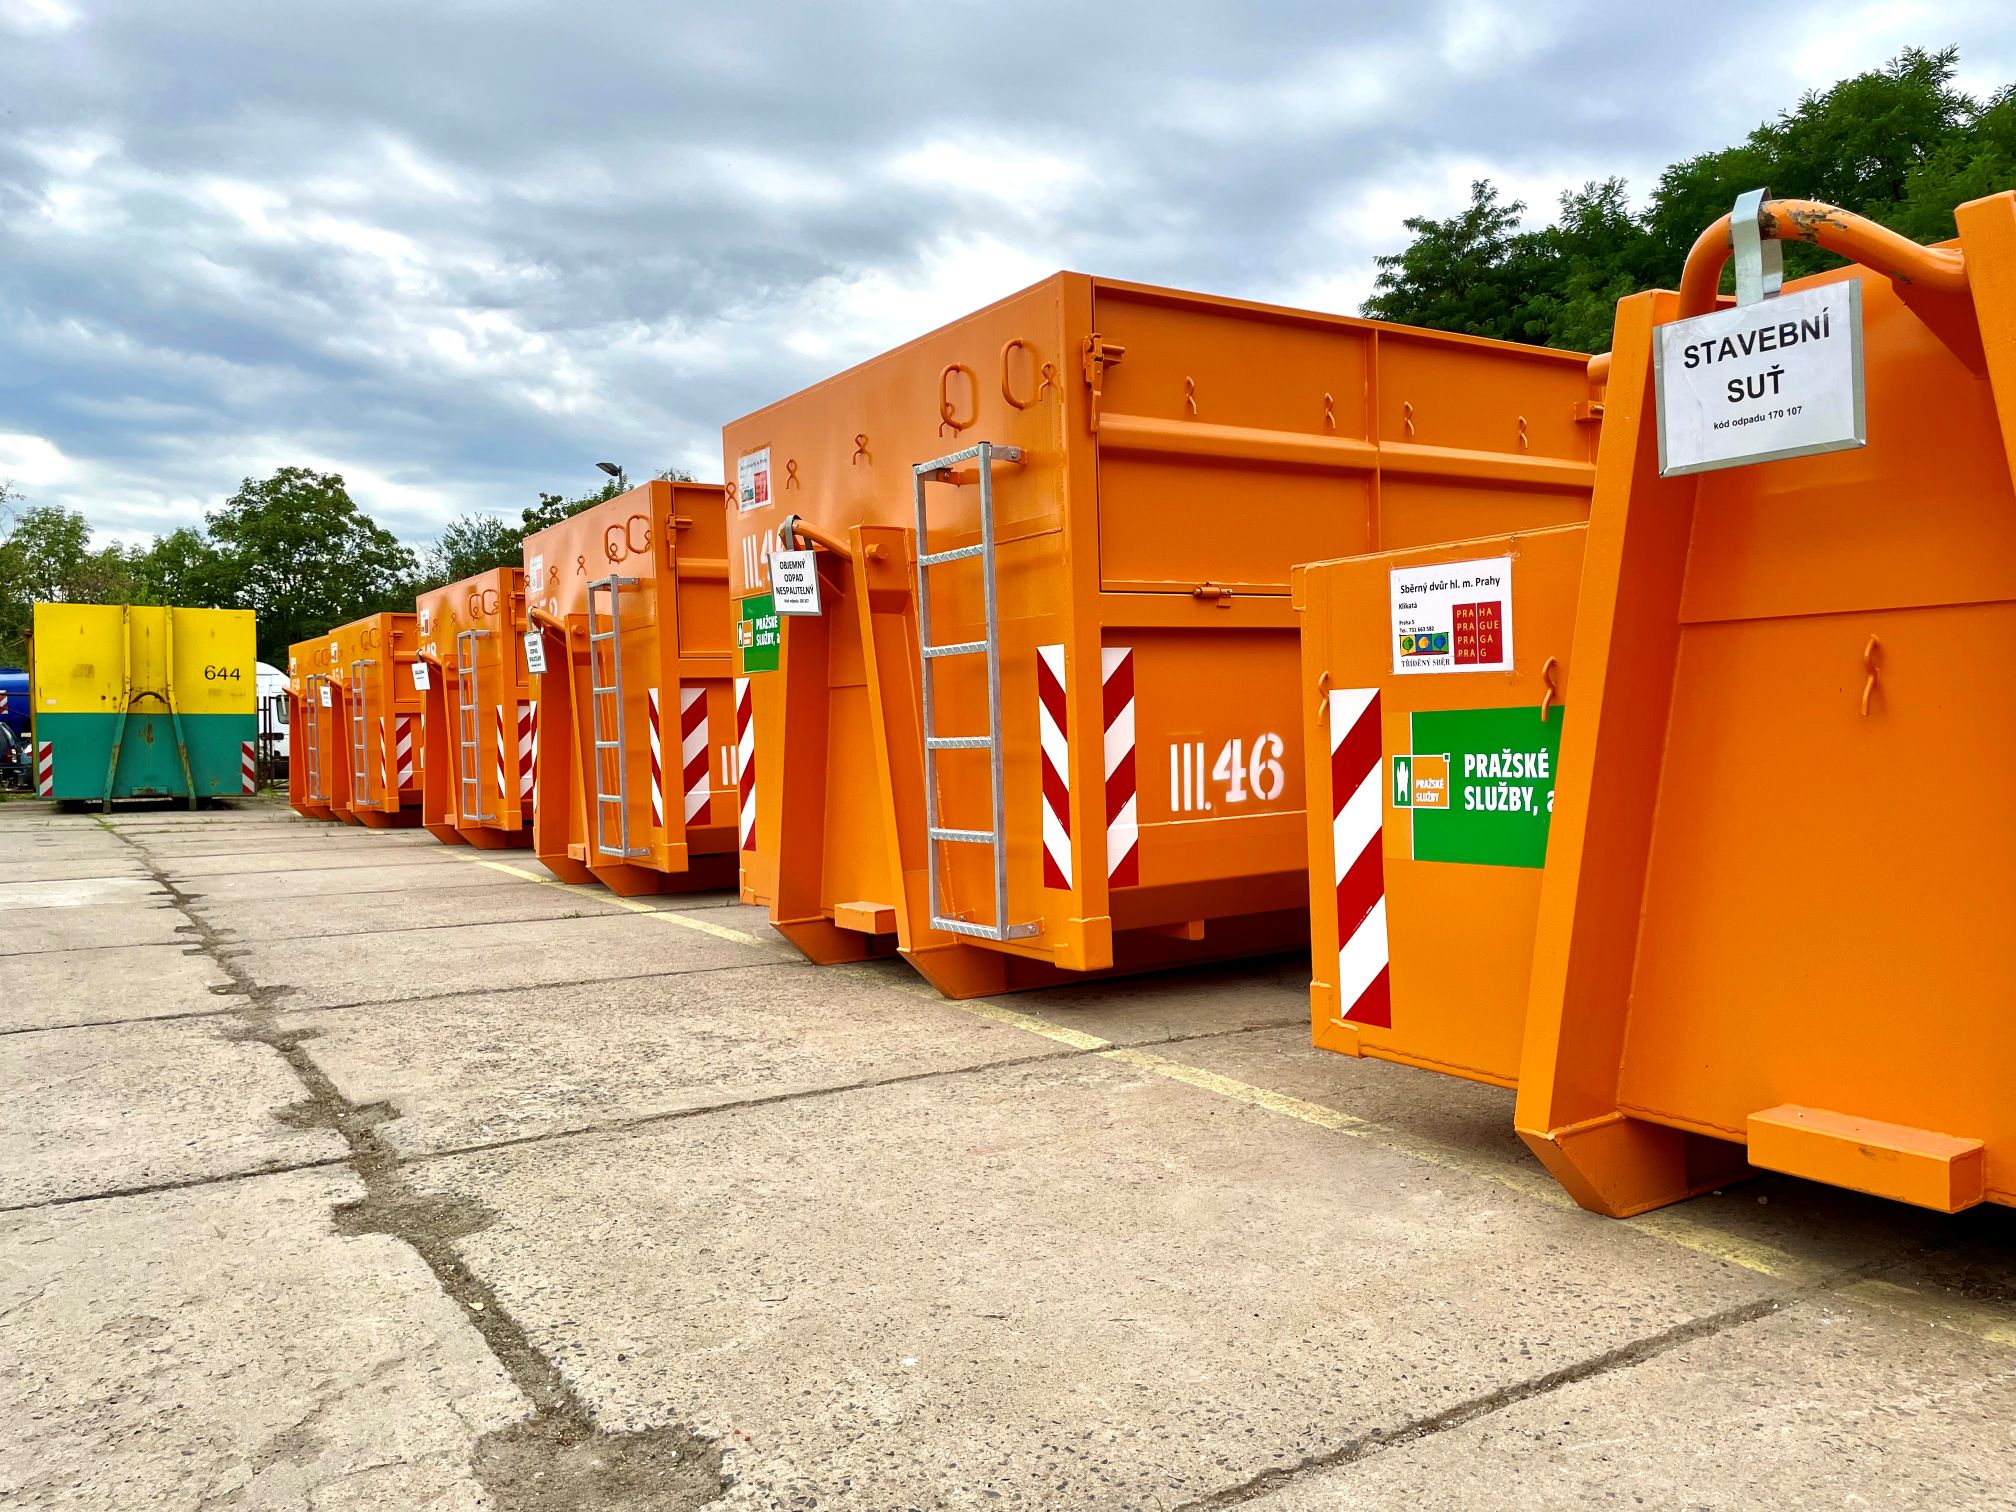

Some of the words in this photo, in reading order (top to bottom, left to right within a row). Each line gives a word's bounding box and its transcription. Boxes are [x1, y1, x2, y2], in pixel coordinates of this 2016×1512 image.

[1683, 307, 1830, 369] STAVEBNÍ
[1727, 364, 1785, 403] SUŤ
[1713, 419, 1730, 430] kód
[1732, 413, 1766, 428] odpadu
[1768, 409, 1784, 420] 170
[1786, 406, 1803, 417] 107
[779, 558, 805, 570] OBJEMNÝ
[784, 573, 804, 582] ODPAD
[775, 584, 814, 595] NESPALITELNÝ
[1400, 582, 1428, 594] Sběrný
[1429, 580, 1448, 591] dvůr
[1450, 579, 1460, 589] hl.
[1462, 580, 1473, 588] m.
[1475, 576, 1500, 587] Prahy
[1398, 602, 1418, 610] Klikatá
[1456, 609, 1475, 618] PRA
[1479, 607, 1493, 616] HA
[1457, 622, 1475, 631] PRA
[1479, 620, 1500, 630] GUE
[1457, 636, 1475, 645] PRA
[1480, 635, 1493, 644] GA
[1458, 649, 1476, 657] PRA
[1480, 648, 1487, 657] G
[204, 664, 241, 681] 644
[1464, 747, 1550, 779] PRAŽSKÉ
[1170, 732, 1284, 812] III.46
[1415, 778, 1444, 790] PRAŽSKÉ
[1415, 791, 1440, 803] SLUŽBY
[1464, 781, 1539, 816] SLUŽBY,
